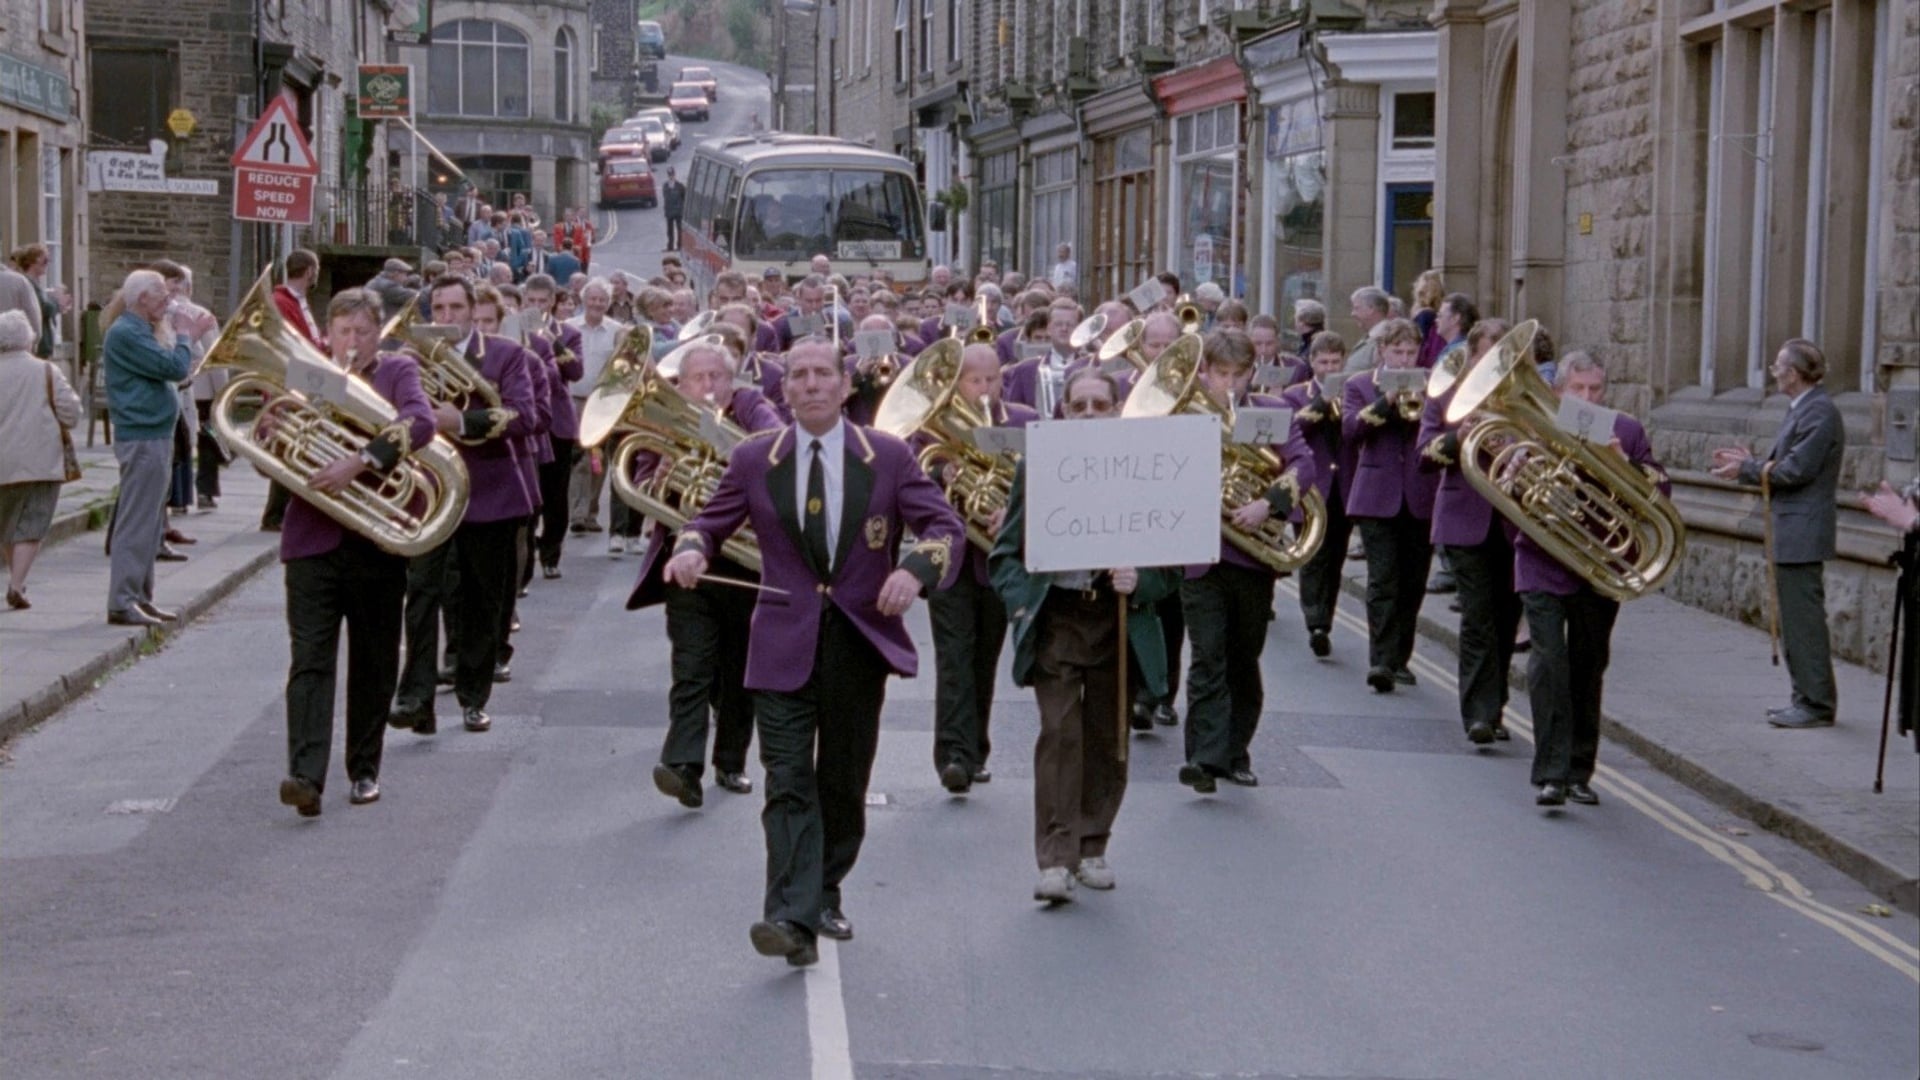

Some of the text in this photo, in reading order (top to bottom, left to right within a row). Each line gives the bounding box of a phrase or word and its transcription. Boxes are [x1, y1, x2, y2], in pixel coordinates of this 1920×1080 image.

[247, 171, 301, 189] REDUCE
[253, 188, 296, 205] SPEED
[256, 205, 289, 219] NOW
[1057, 453, 1190, 483] GRIMLEY
[1044, 506, 1186, 537] COLLIERY
